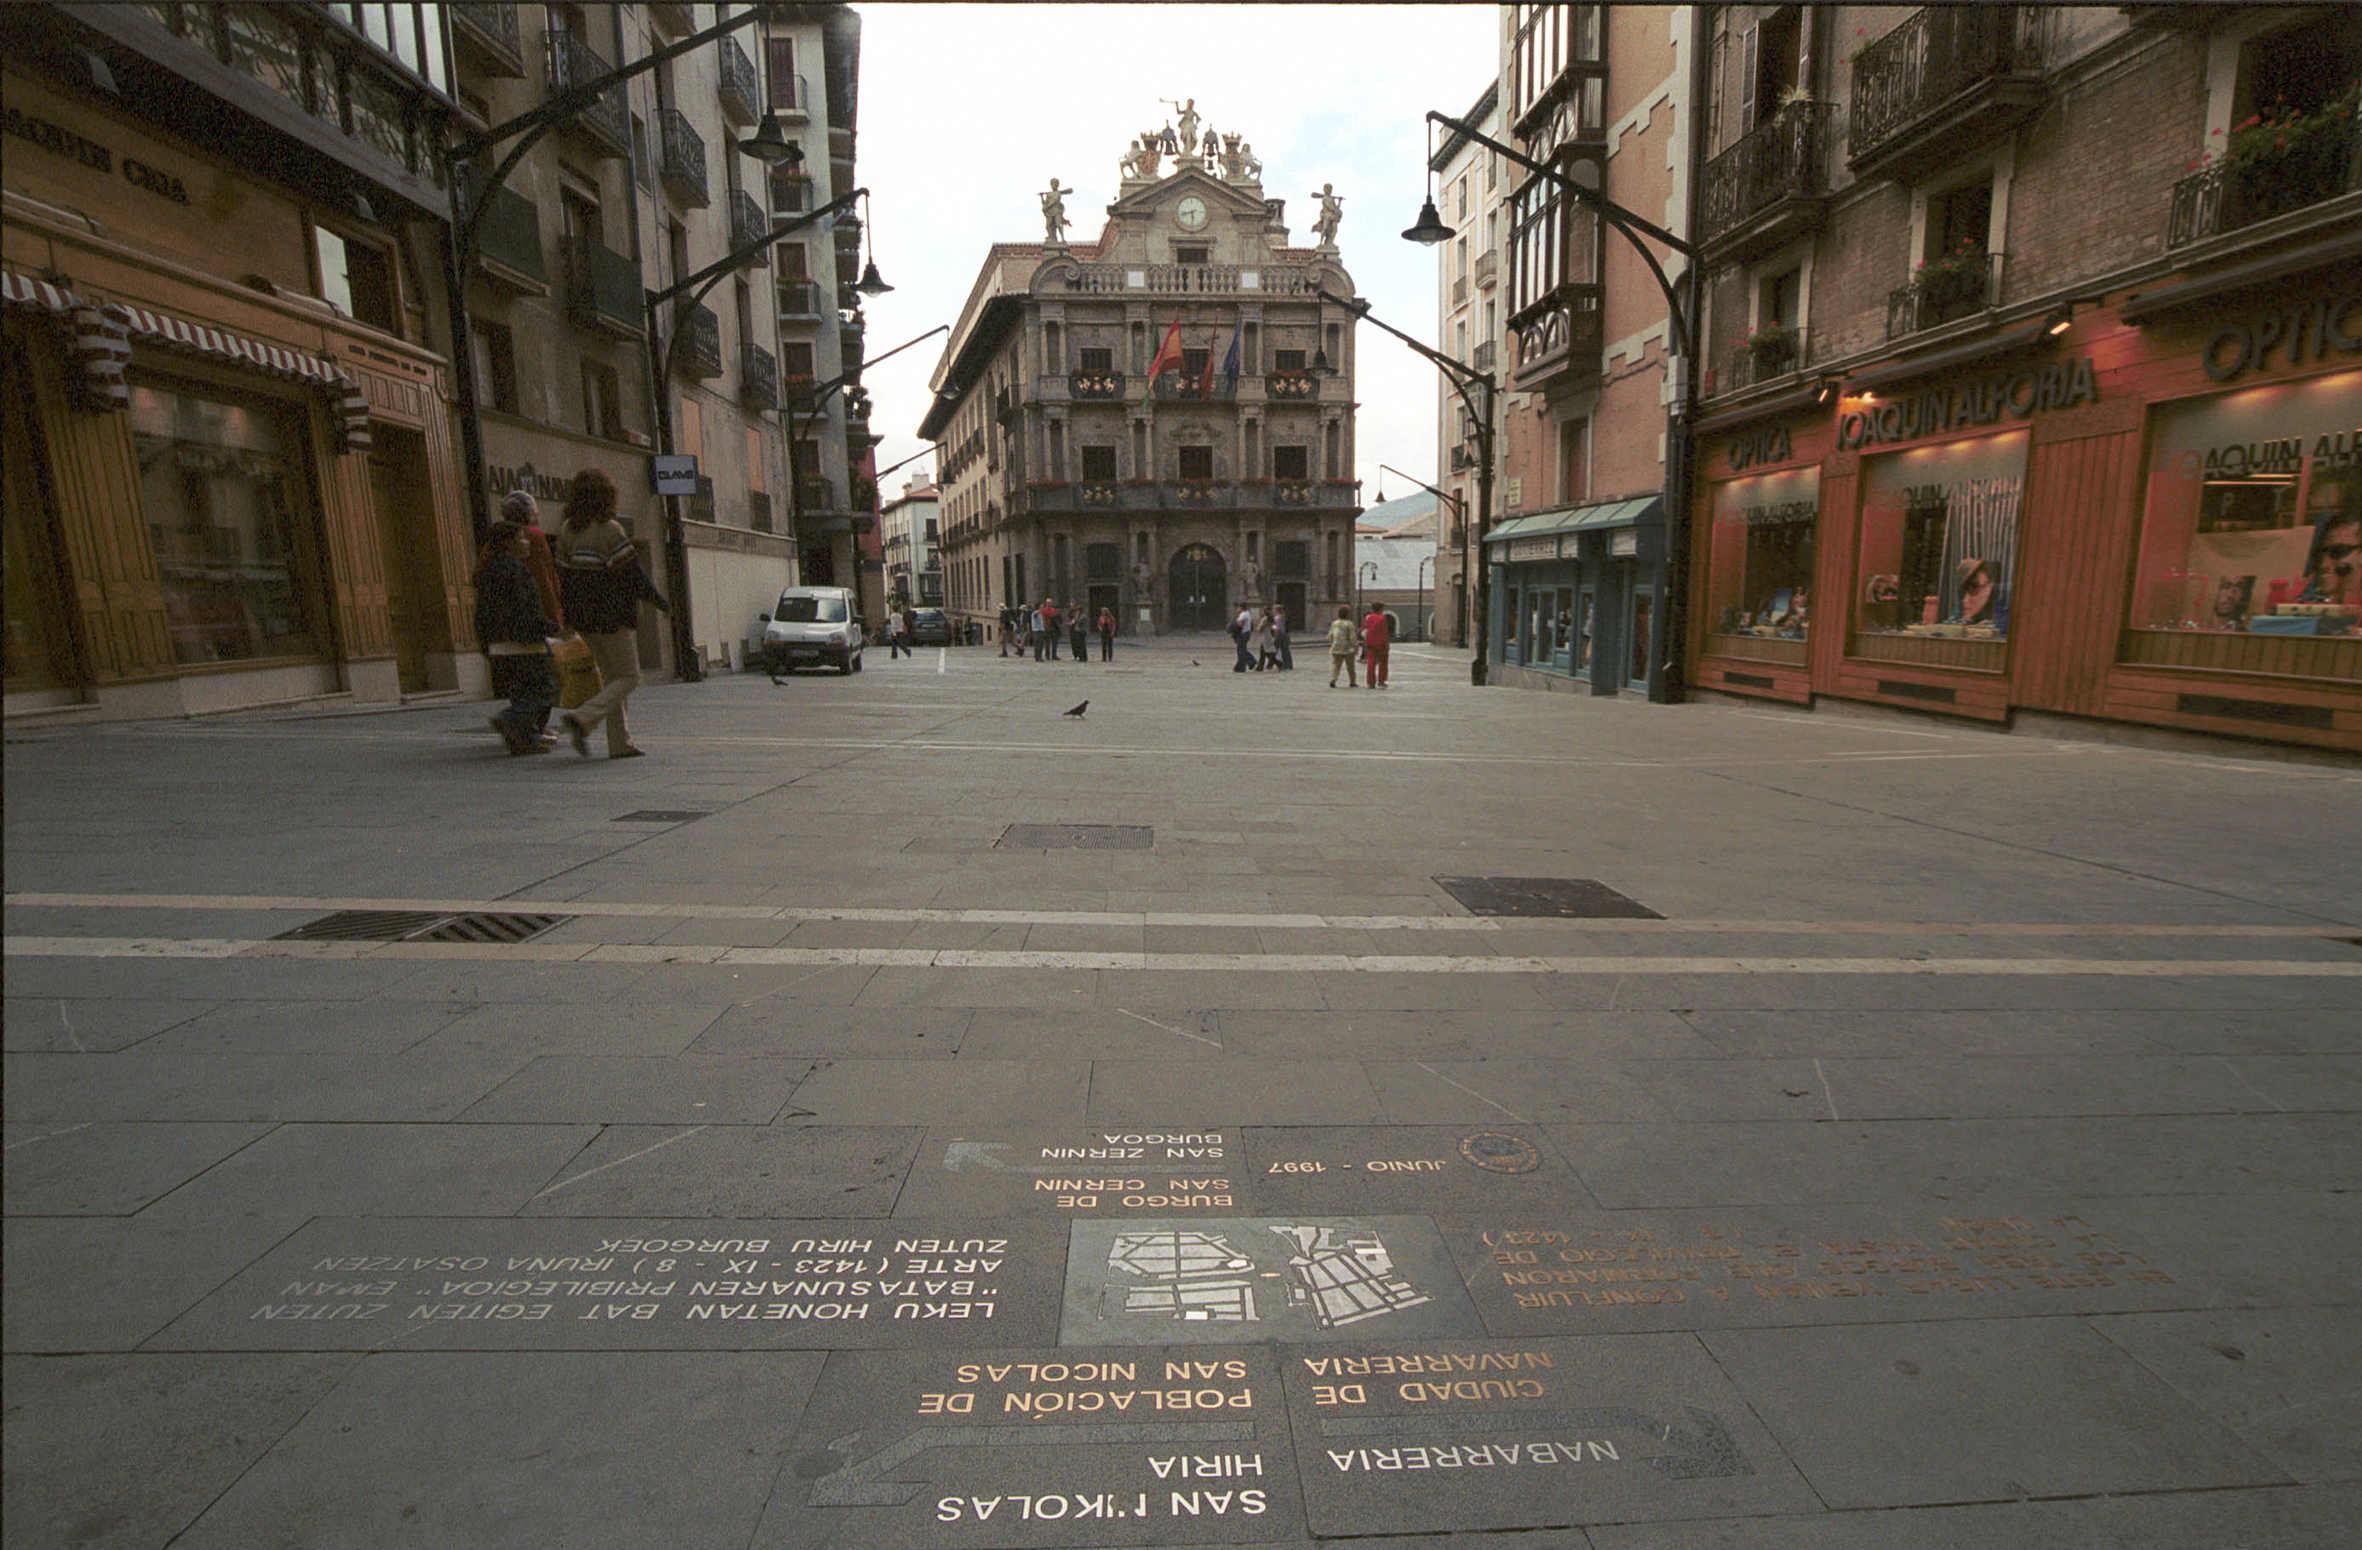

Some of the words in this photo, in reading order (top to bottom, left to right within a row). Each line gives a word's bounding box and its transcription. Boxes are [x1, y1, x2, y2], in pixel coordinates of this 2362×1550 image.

[1836, 390, 1950, 451] JOAQUIN
[1954, 355, 2099, 427] ALFORJA
[1728, 425, 1792, 471] OPTICA
[2168, 436, 2303, 483] JOAQUIN
[658, 469, 694, 480] CLAVE
[1104, 1133, 1223, 1145] BURGOA
[1041, 1147, 1145, 1159] ZERNIN
[1166, 1147, 1224, 1159] SAN
[1269, 1161, 1326, 1174] 1997
[1367, 1160, 1447, 1172] JUNIO
[1035, 1179, 1146, 1191] CERNIN
[1169, 1178, 1229, 1191] SAN
[1057, 1195, 1098, 1208] DE
[1122, 1195, 1233, 1207] BURGO
[593, 1238, 771, 1254] BURGOEK
[791, 1238, 874, 1254] HIRU
[895, 1238, 1008, 1254] ZUTEN
[312, 1256, 490, 1271] OSATZEN
[721, 1257, 759, 1274] IX
[904, 1257, 1003, 1273] ARTE
[1492, 1249, 1540, 1266] DE
[1501, 1265, 1702, 1286] FORMARON
[279, 1279, 399, 1297] EMAN
[1513, 1287, 1685, 1307] CONFLUIR
[248, 1302, 390, 1320] ZUTEN
[406, 1302, 555, 1320] EGITEN
[577, 1303, 660, 1320] BAT
[684, 1302, 870, 1320] HONETAN
[892, 1301, 996, 1319] LEKU
[1164, 1360, 1247, 1381] SAN
[1302, 1350, 1554, 1377] NAVARRERIA
[955, 1362, 1137, 1384] NICOLAS
[1311, 1384, 1367, 1405] DE
[1399, 1379, 1545, 1403] CIUDAD
[917, 1392, 976, 1414] DE
[1003, 1388, 1253, 1419] POBLACIÓN
[1326, 1439, 1621, 1472] NABARRERIA
[1147, 1453, 1263, 1479] HIRIA
[1170, 1489, 1267, 1517] SAN
